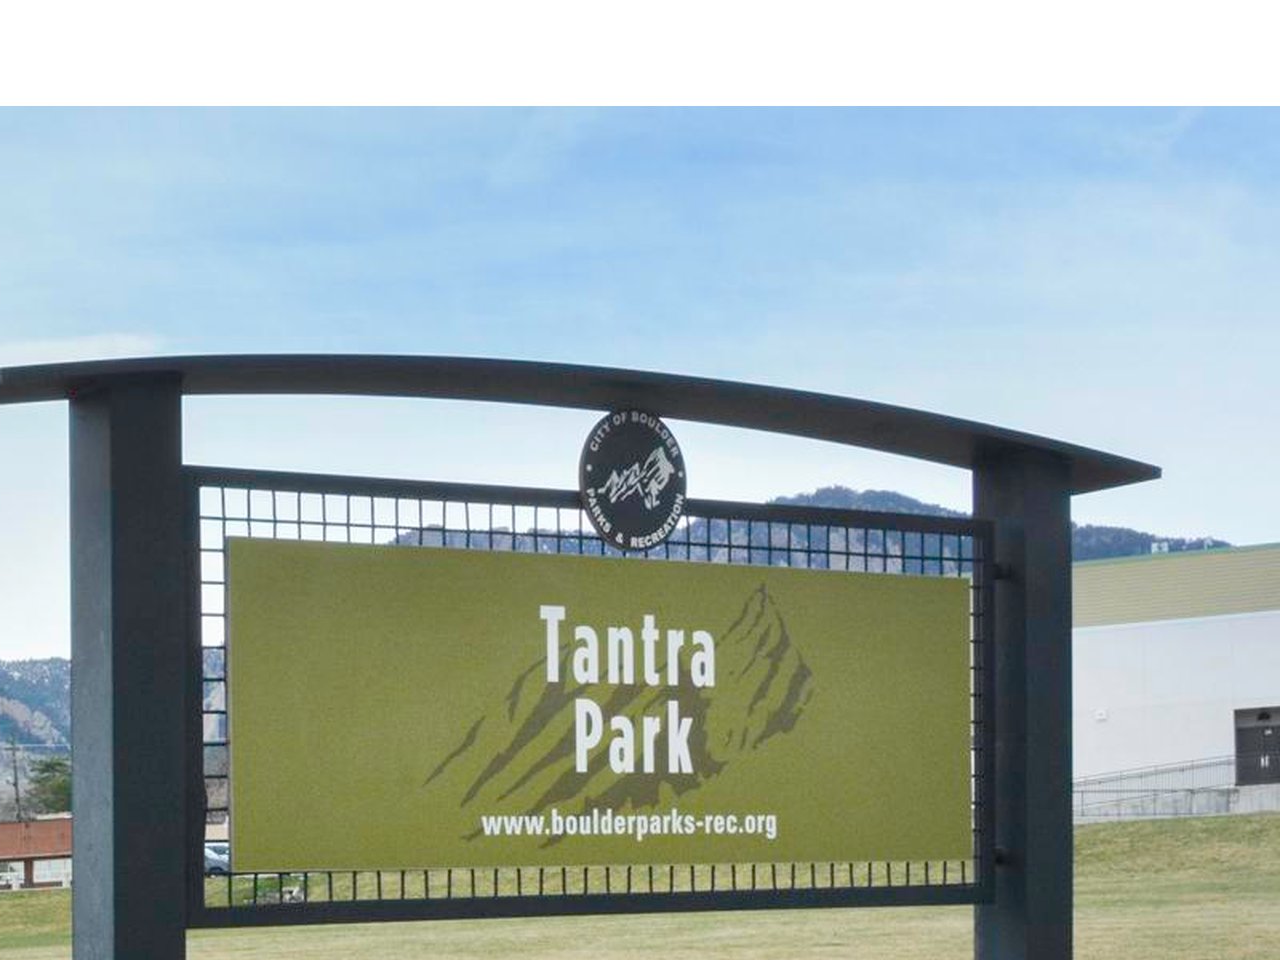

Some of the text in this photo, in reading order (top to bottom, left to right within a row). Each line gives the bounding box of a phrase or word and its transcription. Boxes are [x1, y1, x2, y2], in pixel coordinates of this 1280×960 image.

[589, 411, 680, 458] CITY OF BOULDER
[586, 487, 684, 548] PARKS & RECREATION
[539, 604, 717, 687] Tantra
[574, 698, 694, 774] Park
[481, 807, 778, 842] www.boulderparks-rec.org
